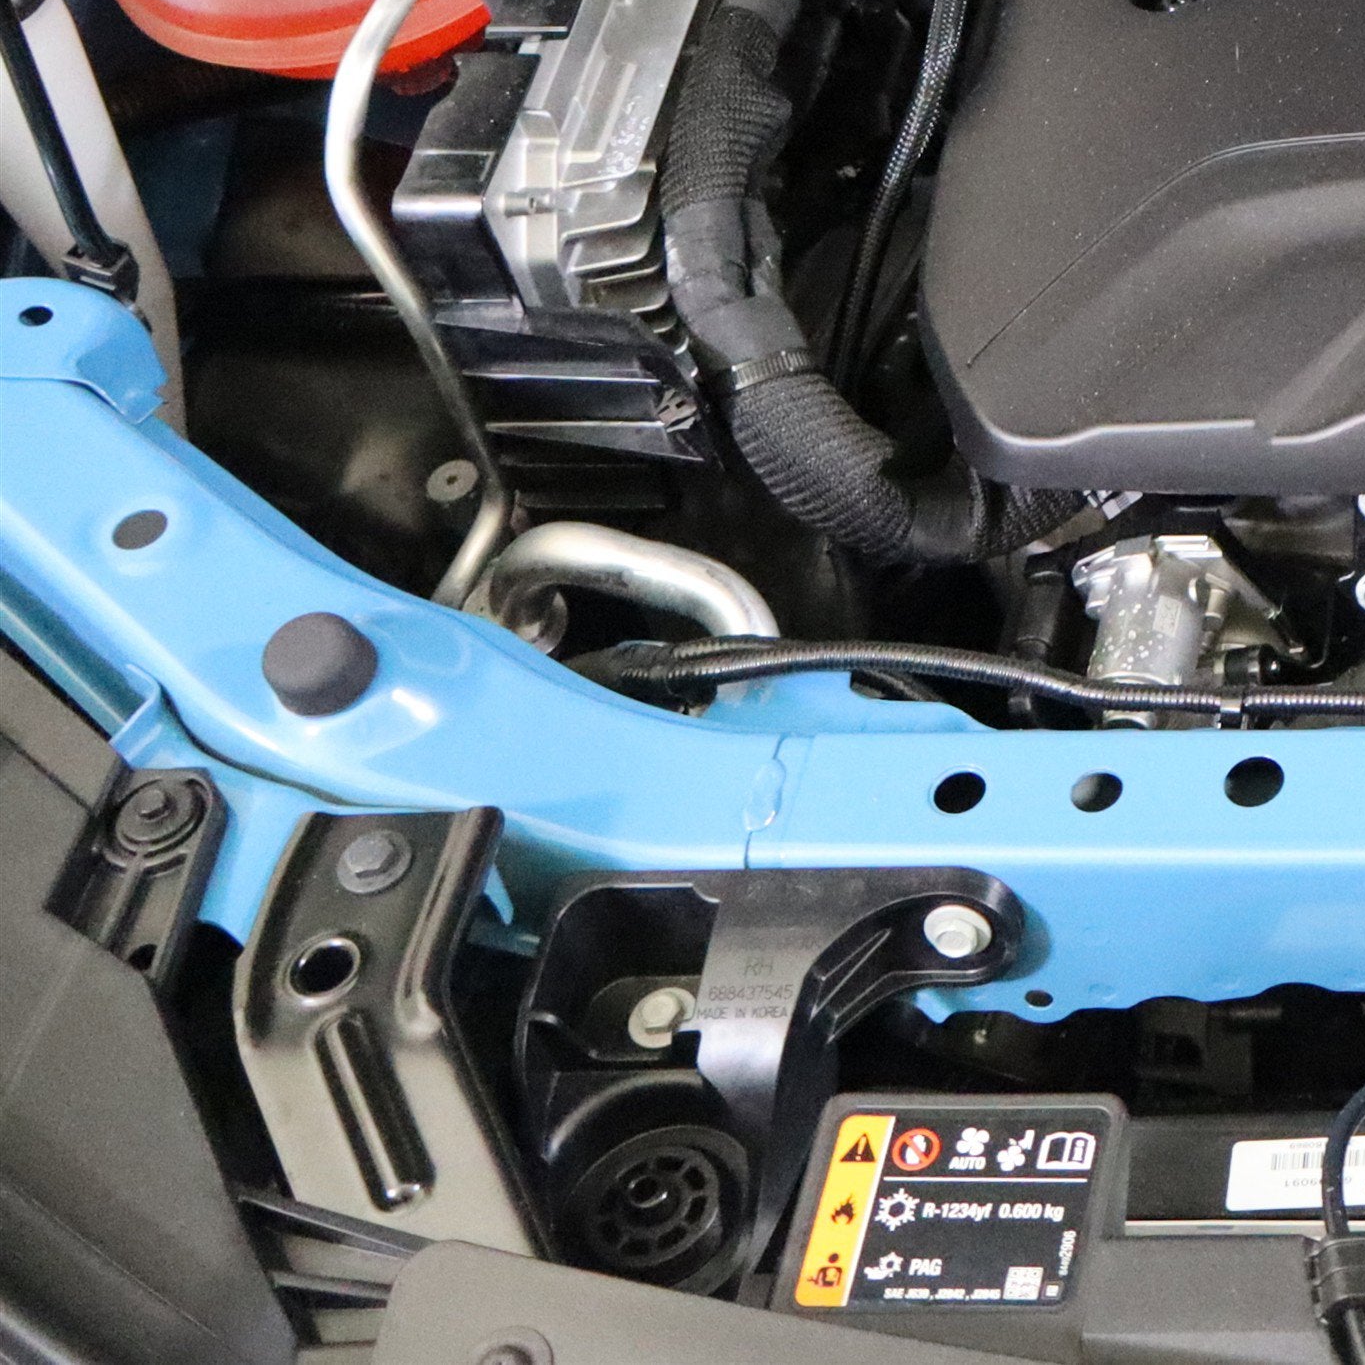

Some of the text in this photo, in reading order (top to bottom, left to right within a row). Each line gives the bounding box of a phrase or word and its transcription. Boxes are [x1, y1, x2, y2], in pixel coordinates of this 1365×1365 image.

[696, 1006, 728, 1020] MADE
[751, 1005, 788, 1019] KOREA
[949, 1156, 986, 1170] AUTO
[922, 1202, 1065, 1223] R-1234yf 0.600 kg
[909, 1258, 942, 1276] PAG
[884, 1288, 905, 1299] SAE
